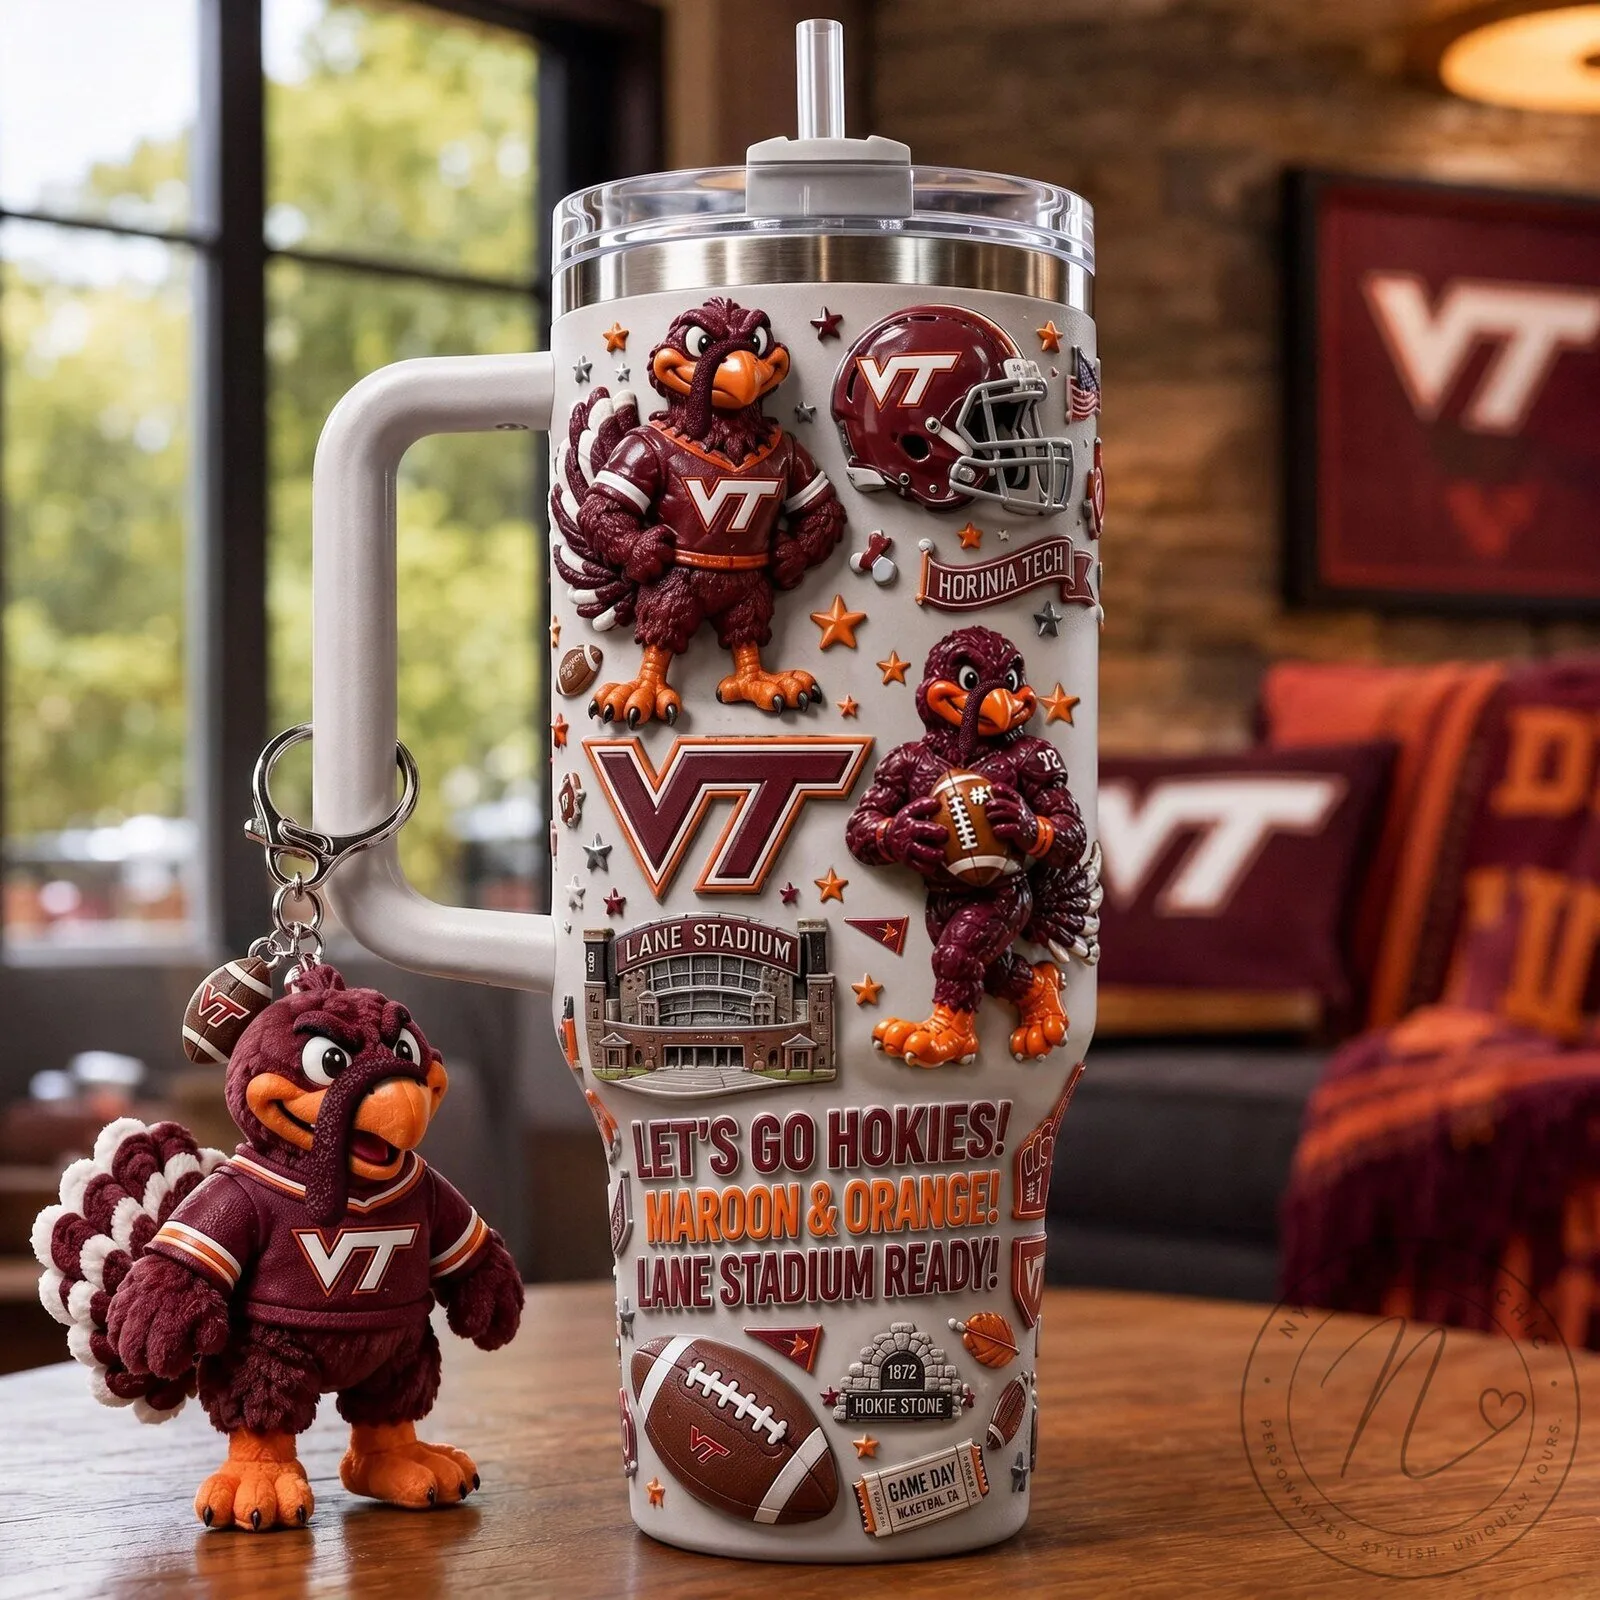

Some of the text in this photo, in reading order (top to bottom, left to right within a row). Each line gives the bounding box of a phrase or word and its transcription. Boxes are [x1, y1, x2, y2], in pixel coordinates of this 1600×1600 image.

[855, 351, 962, 411] VT
[1362, 270, 1600, 436] VT
[681, 476, 782, 532] VT
[1022, 546, 1063, 582] TECH
[582, 736, 876, 900] VT
[626, 925, 682, 963] LANE
[694, 923, 791, 963] STADIUM
[198, 983, 251, 1028] VT
[631, 1099, 1013, 1179] LET'S GO HOKIES!
[645, 1169, 1000, 1244] MAROON & ORANGE!
[292, 1223, 422, 1296] VT
[637, 1236, 1000, 1309] LANE STADIUM READY!
[887, 1364, 917, 1380] 1872
[855, 1397, 944, 1414] HOKIE STONE
[690, 1424, 731, 1464] VT
[888, 1472, 929, 1503] GAME
[930, 1461, 956, 1489] DAY
